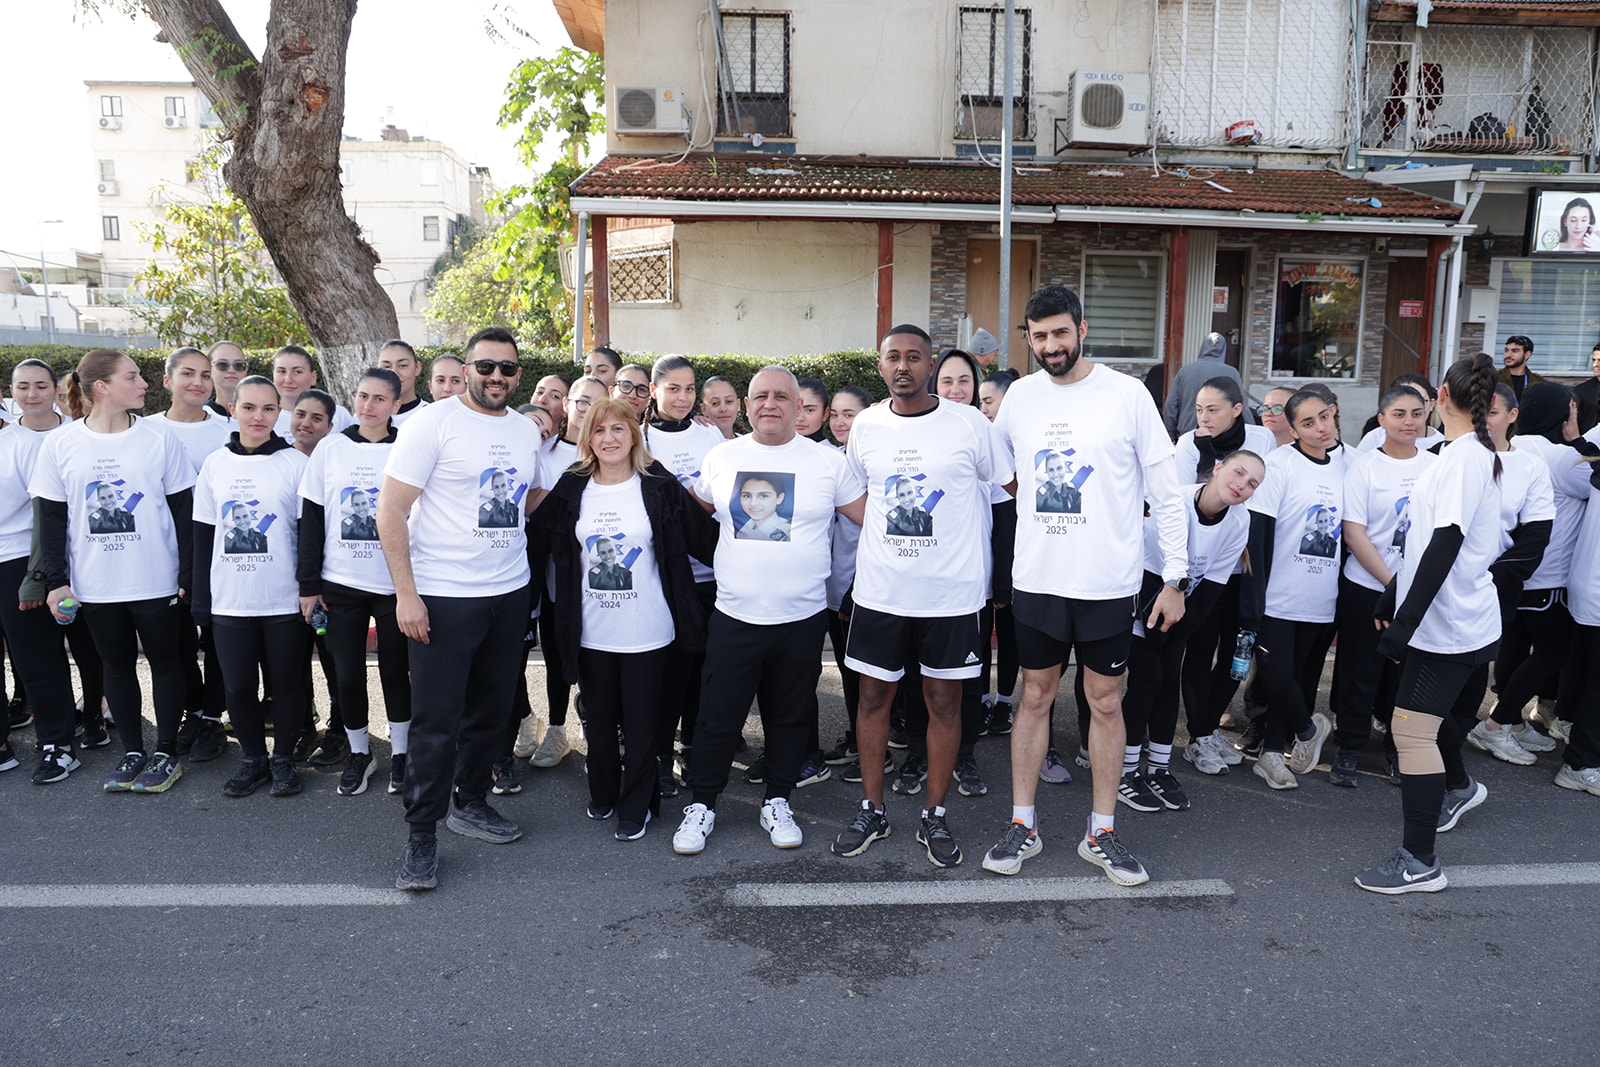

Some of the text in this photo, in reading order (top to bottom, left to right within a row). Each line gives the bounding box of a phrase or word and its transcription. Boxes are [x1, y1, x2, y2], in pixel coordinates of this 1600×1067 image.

[1100, 73, 1124, 81] ELCO
[1033, 513, 1087, 524] גיבורת ישראל
[472, 528, 499, 539] ישראל
[1046, 525, 1068, 535] 2025
[85, 534, 142, 543] גיבורת ישראל
[883, 535, 938, 548] גיבורת ישראל
[103, 543, 125, 551] 2025
[337, 540, 360, 550] ישראל
[490, 540, 510, 549] 2025
[352, 550, 374, 559] 2025
[897, 548, 920, 557] 2025
[220, 555, 274, 563] גיבורת ישראל
[1293, 554, 1316, 565] ישראל
[236, 563, 257, 572] 2025
[585, 589, 638, 600] גיבורת ישראל
[599, 600, 621, 609] 2024
